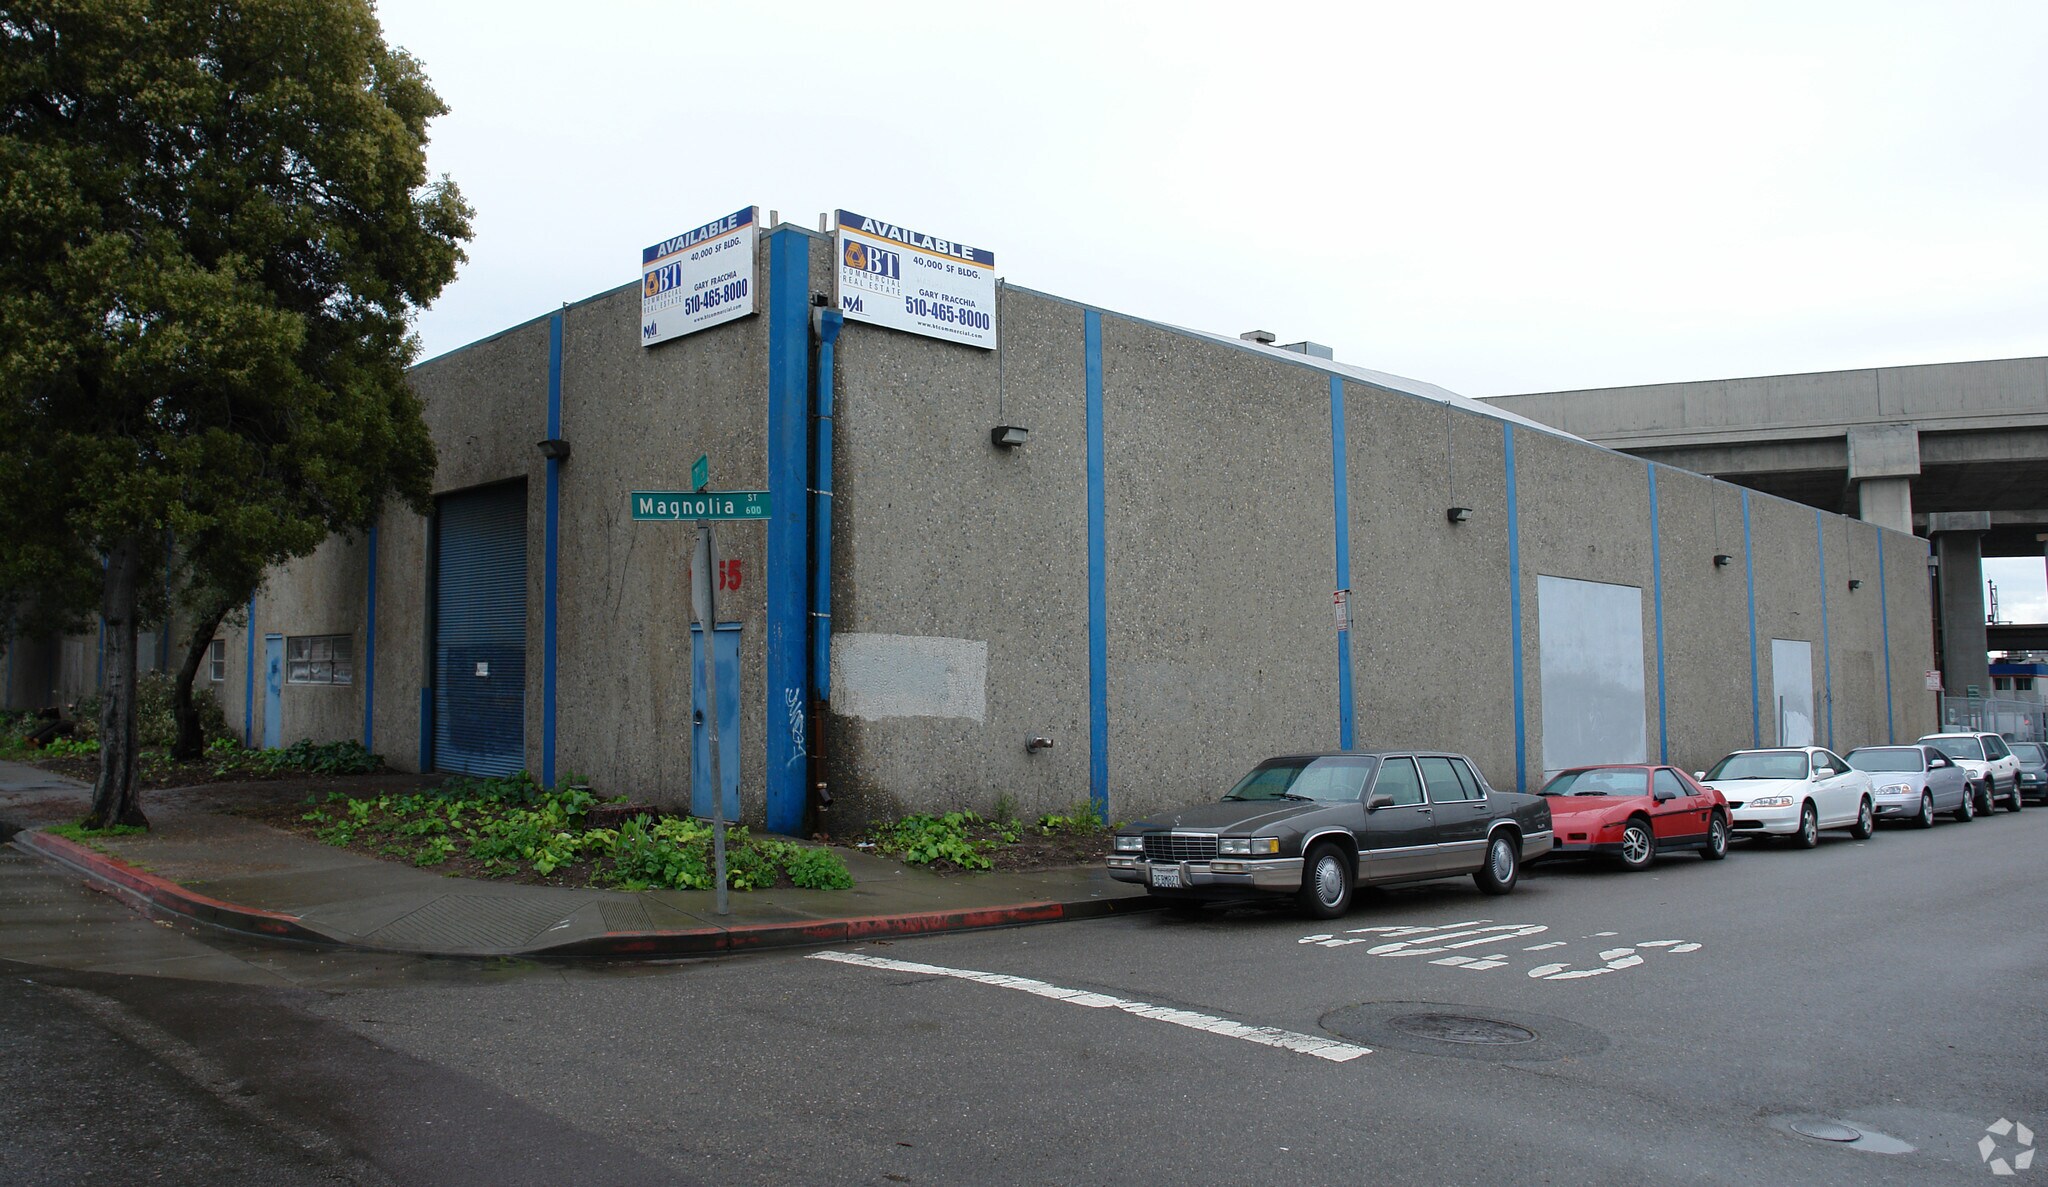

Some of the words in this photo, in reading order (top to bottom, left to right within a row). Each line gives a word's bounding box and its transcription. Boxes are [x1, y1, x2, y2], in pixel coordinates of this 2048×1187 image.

[656, 213, 738, 258] AVAILABLE
[861, 217, 974, 261] AVAILABLE
[690, 246, 713, 262] 40,000
[714, 243, 722, 253] SF
[723, 236, 742, 250] BLDG.
[866, 246, 900, 279] BT
[913, 256, 943, 271] 40,000
[946, 264, 955, 273] SF
[957, 267, 981, 280] BLDG.
[658, 262, 682, 292] BT
[694, 279, 709, 291] GARY
[710, 270, 737, 286] FRACCHIA
[842, 266, 901, 288] COMMERCIAL
[842, 276, 864, 287] REAL
[869, 281, 901, 296] ESTATE
[643, 287, 682, 307] COMMERCIAL
[643, 304, 658, 314] REAL
[660, 296, 682, 309] ESTATE
[684, 277, 748, 316] 510-465-8000
[918, 288, 939, 300] GARY
[941, 293, 977, 308] FRACCHIA
[905, 295, 990, 331] 510-465-8000
[917, 320, 983, 339] www.btcommercial.com
[747, 493, 758, 502] ST
[639, 498, 735, 519] Magnolia
[745, 506, 762, 515] 600
